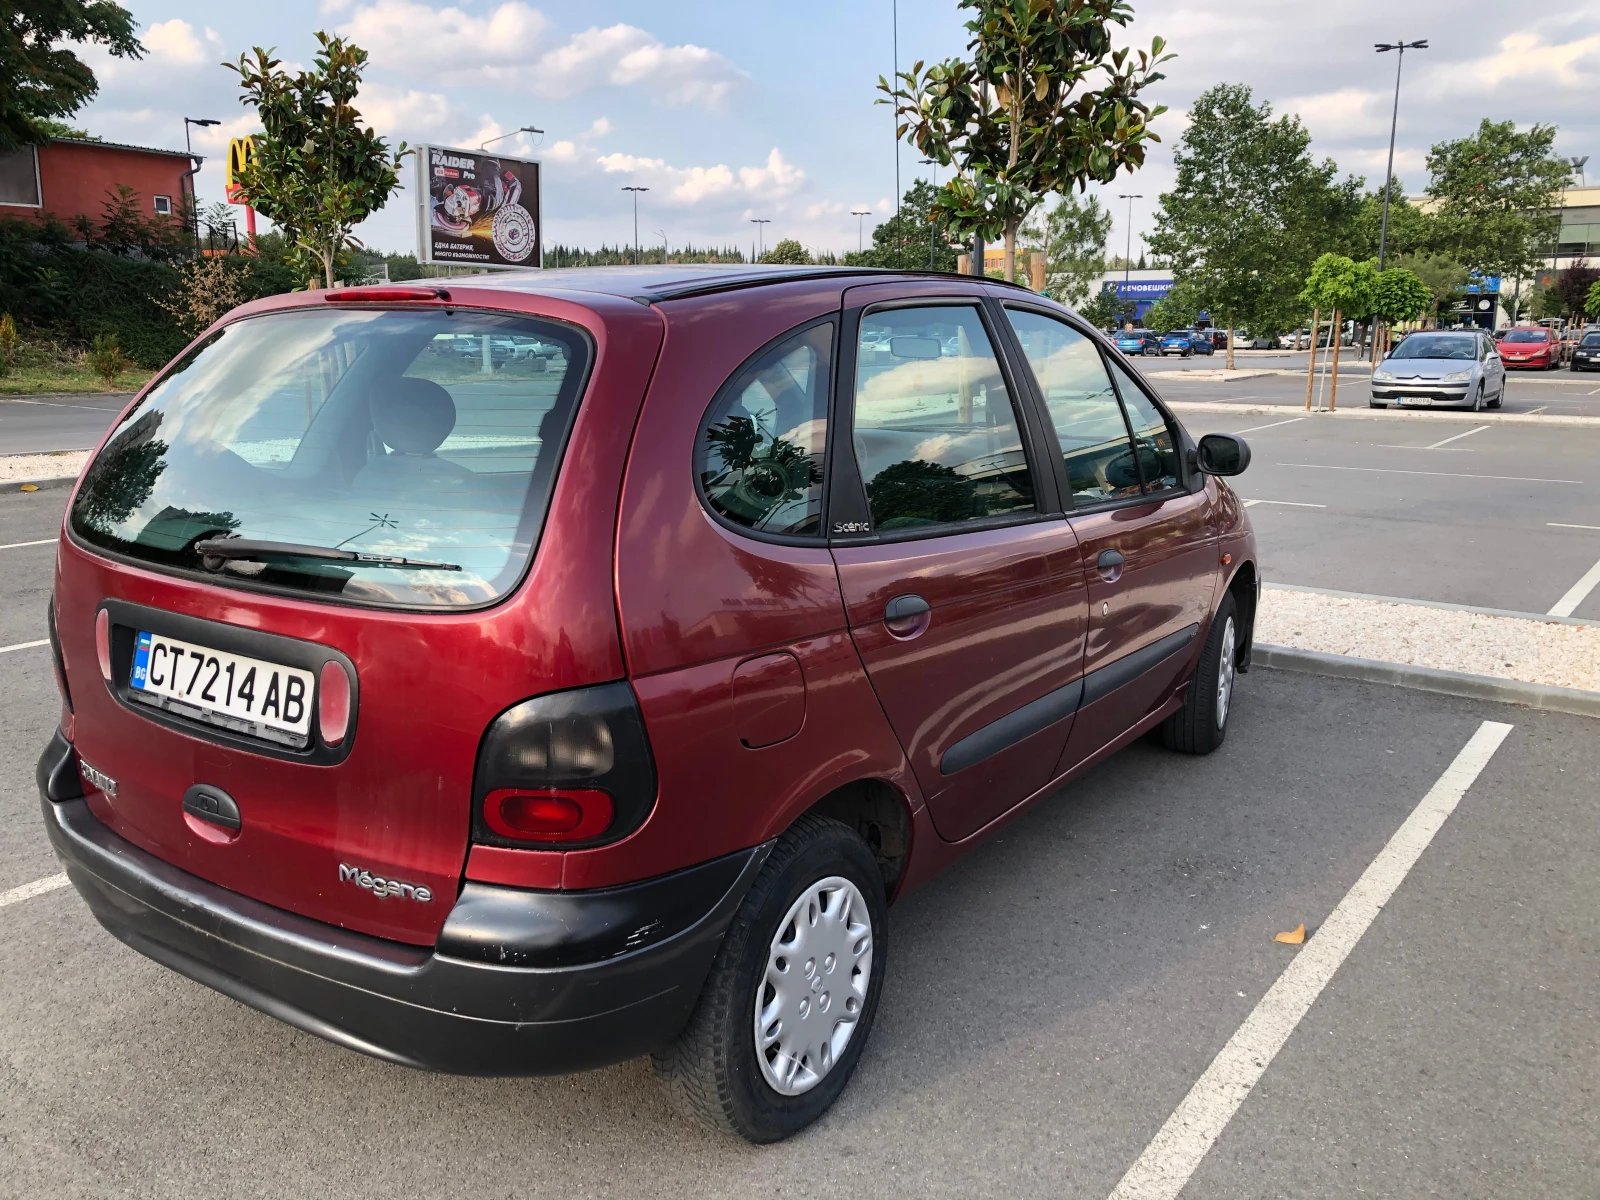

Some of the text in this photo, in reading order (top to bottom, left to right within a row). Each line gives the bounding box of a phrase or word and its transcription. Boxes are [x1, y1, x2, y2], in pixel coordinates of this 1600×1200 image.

[432, 153, 475, 170] RAIDER
[463, 171, 476, 179] Pro
[434, 241, 449, 249] ЕДНА
[134, 665, 147, 680] BG
[186, 651, 257, 712] 7214
[261, 671, 305, 723] AB
[338, 863, 432, 901] Mégane
